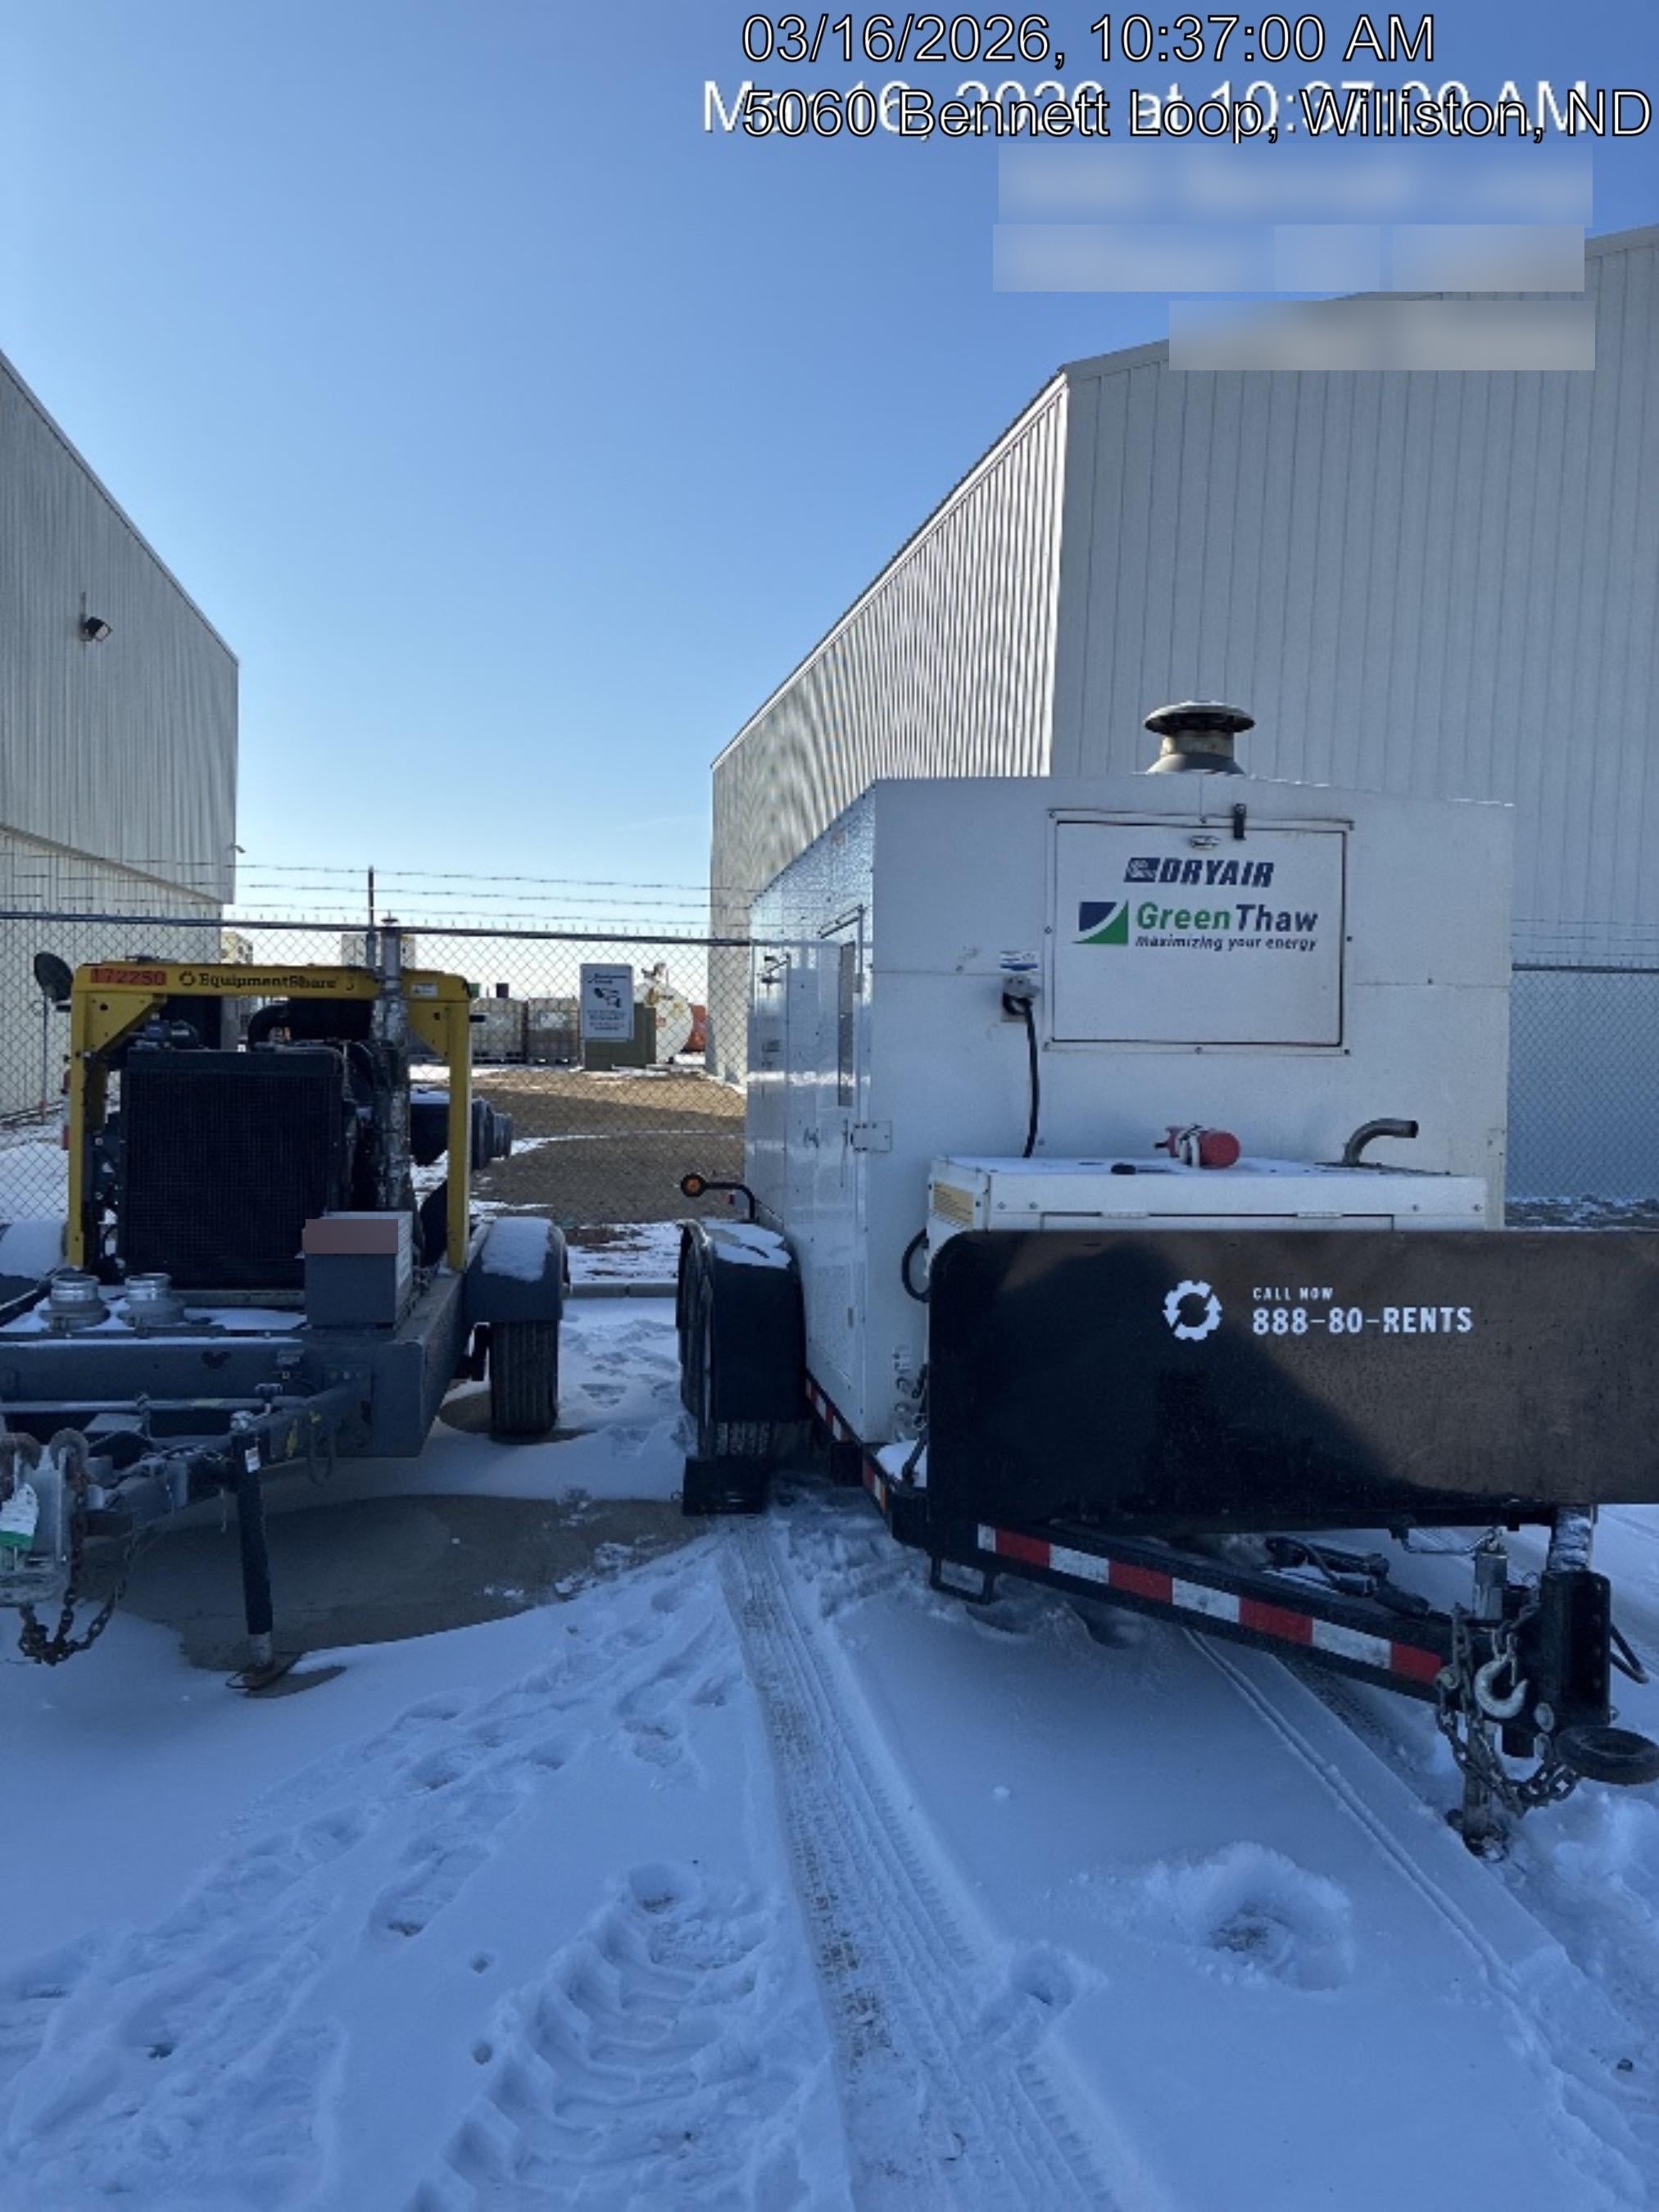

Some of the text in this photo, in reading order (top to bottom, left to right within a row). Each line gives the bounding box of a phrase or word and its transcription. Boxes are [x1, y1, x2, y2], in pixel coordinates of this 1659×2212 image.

[1158, 858, 1274, 887] DRYAIR
[1265, 937, 1317, 952] energy
[198, 972, 337, 990] EquipmentShare
[1252, 1287, 1334, 1301] CALL NOW
[1252, 1307, 1474, 1335] 888-80-RENTS
